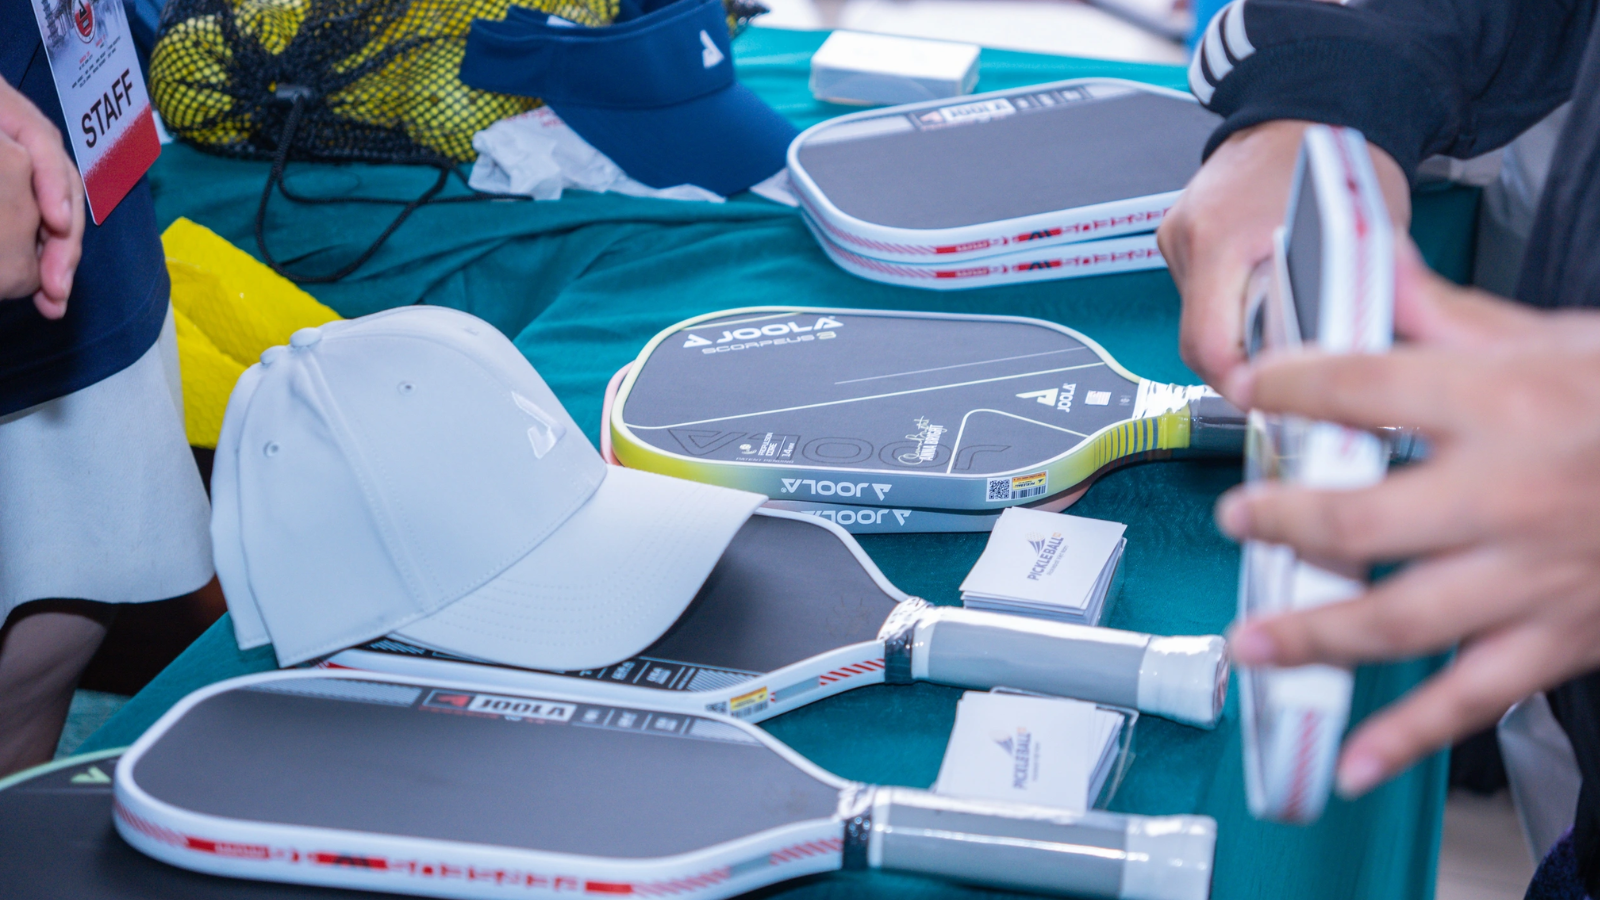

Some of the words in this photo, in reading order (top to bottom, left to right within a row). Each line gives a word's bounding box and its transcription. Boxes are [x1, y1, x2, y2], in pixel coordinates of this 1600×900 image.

[81, 68, 133, 148] STAFF
[716, 317, 844, 343] JOOLA
[702, 334, 815, 354] SCORPEUS
[1057, 383, 1077, 412] JOOLA
[781, 478, 869, 497] JOOLA
[801, 509, 890, 525] JOOL
[1027, 536, 1064, 581] PICKLEBALL
[477, 698, 566, 718] JOOLA
